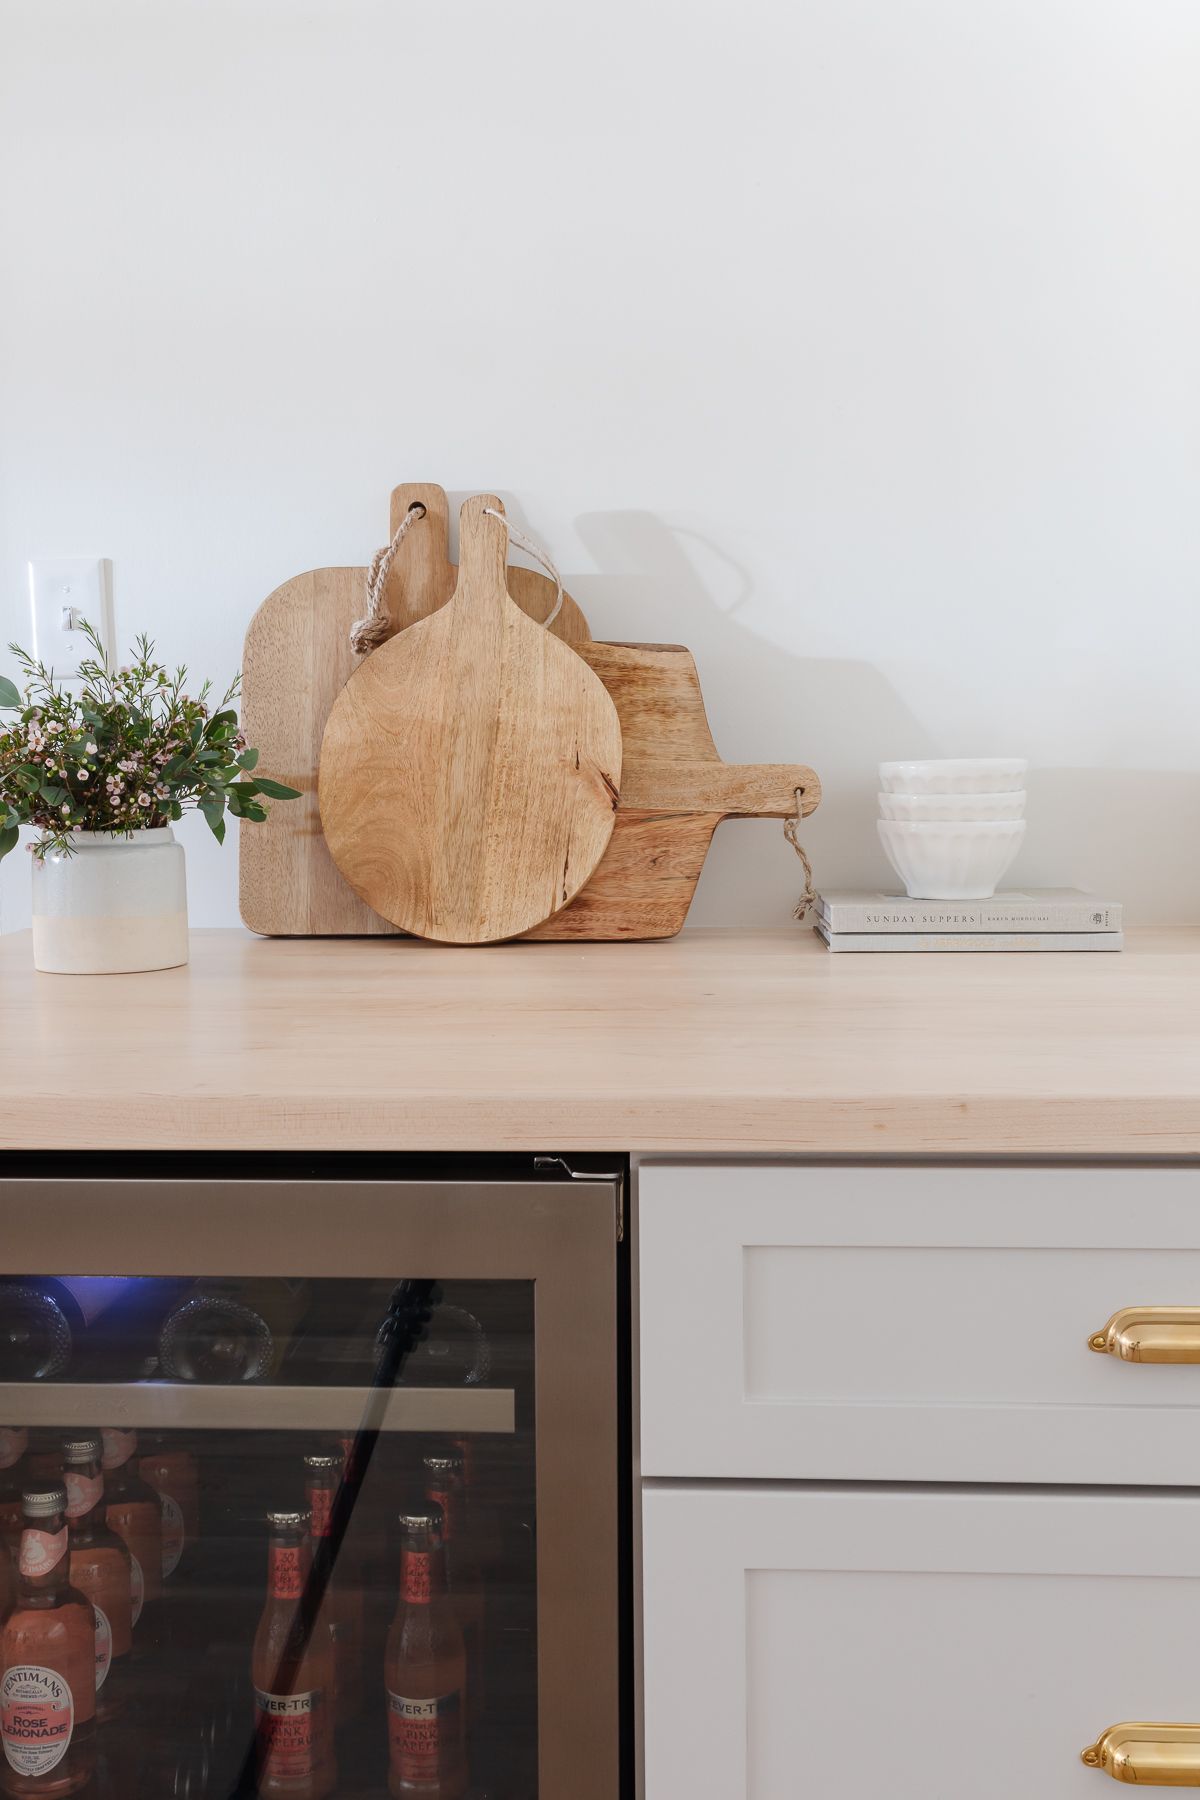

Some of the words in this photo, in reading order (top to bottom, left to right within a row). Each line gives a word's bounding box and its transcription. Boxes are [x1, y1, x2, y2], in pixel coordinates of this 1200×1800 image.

[866, 915, 915, 923] SUNDAY
[922, 915, 975, 923] SUPPERS
[4, 1672, 62, 1698] FENTIMANS
[13, 1716, 48, 1728] ROSE
[2, 1720, 67, 1738] LEMONADE
[271, 1727, 301, 1737] PINK
[406, 1729, 438, 1739] PINK
